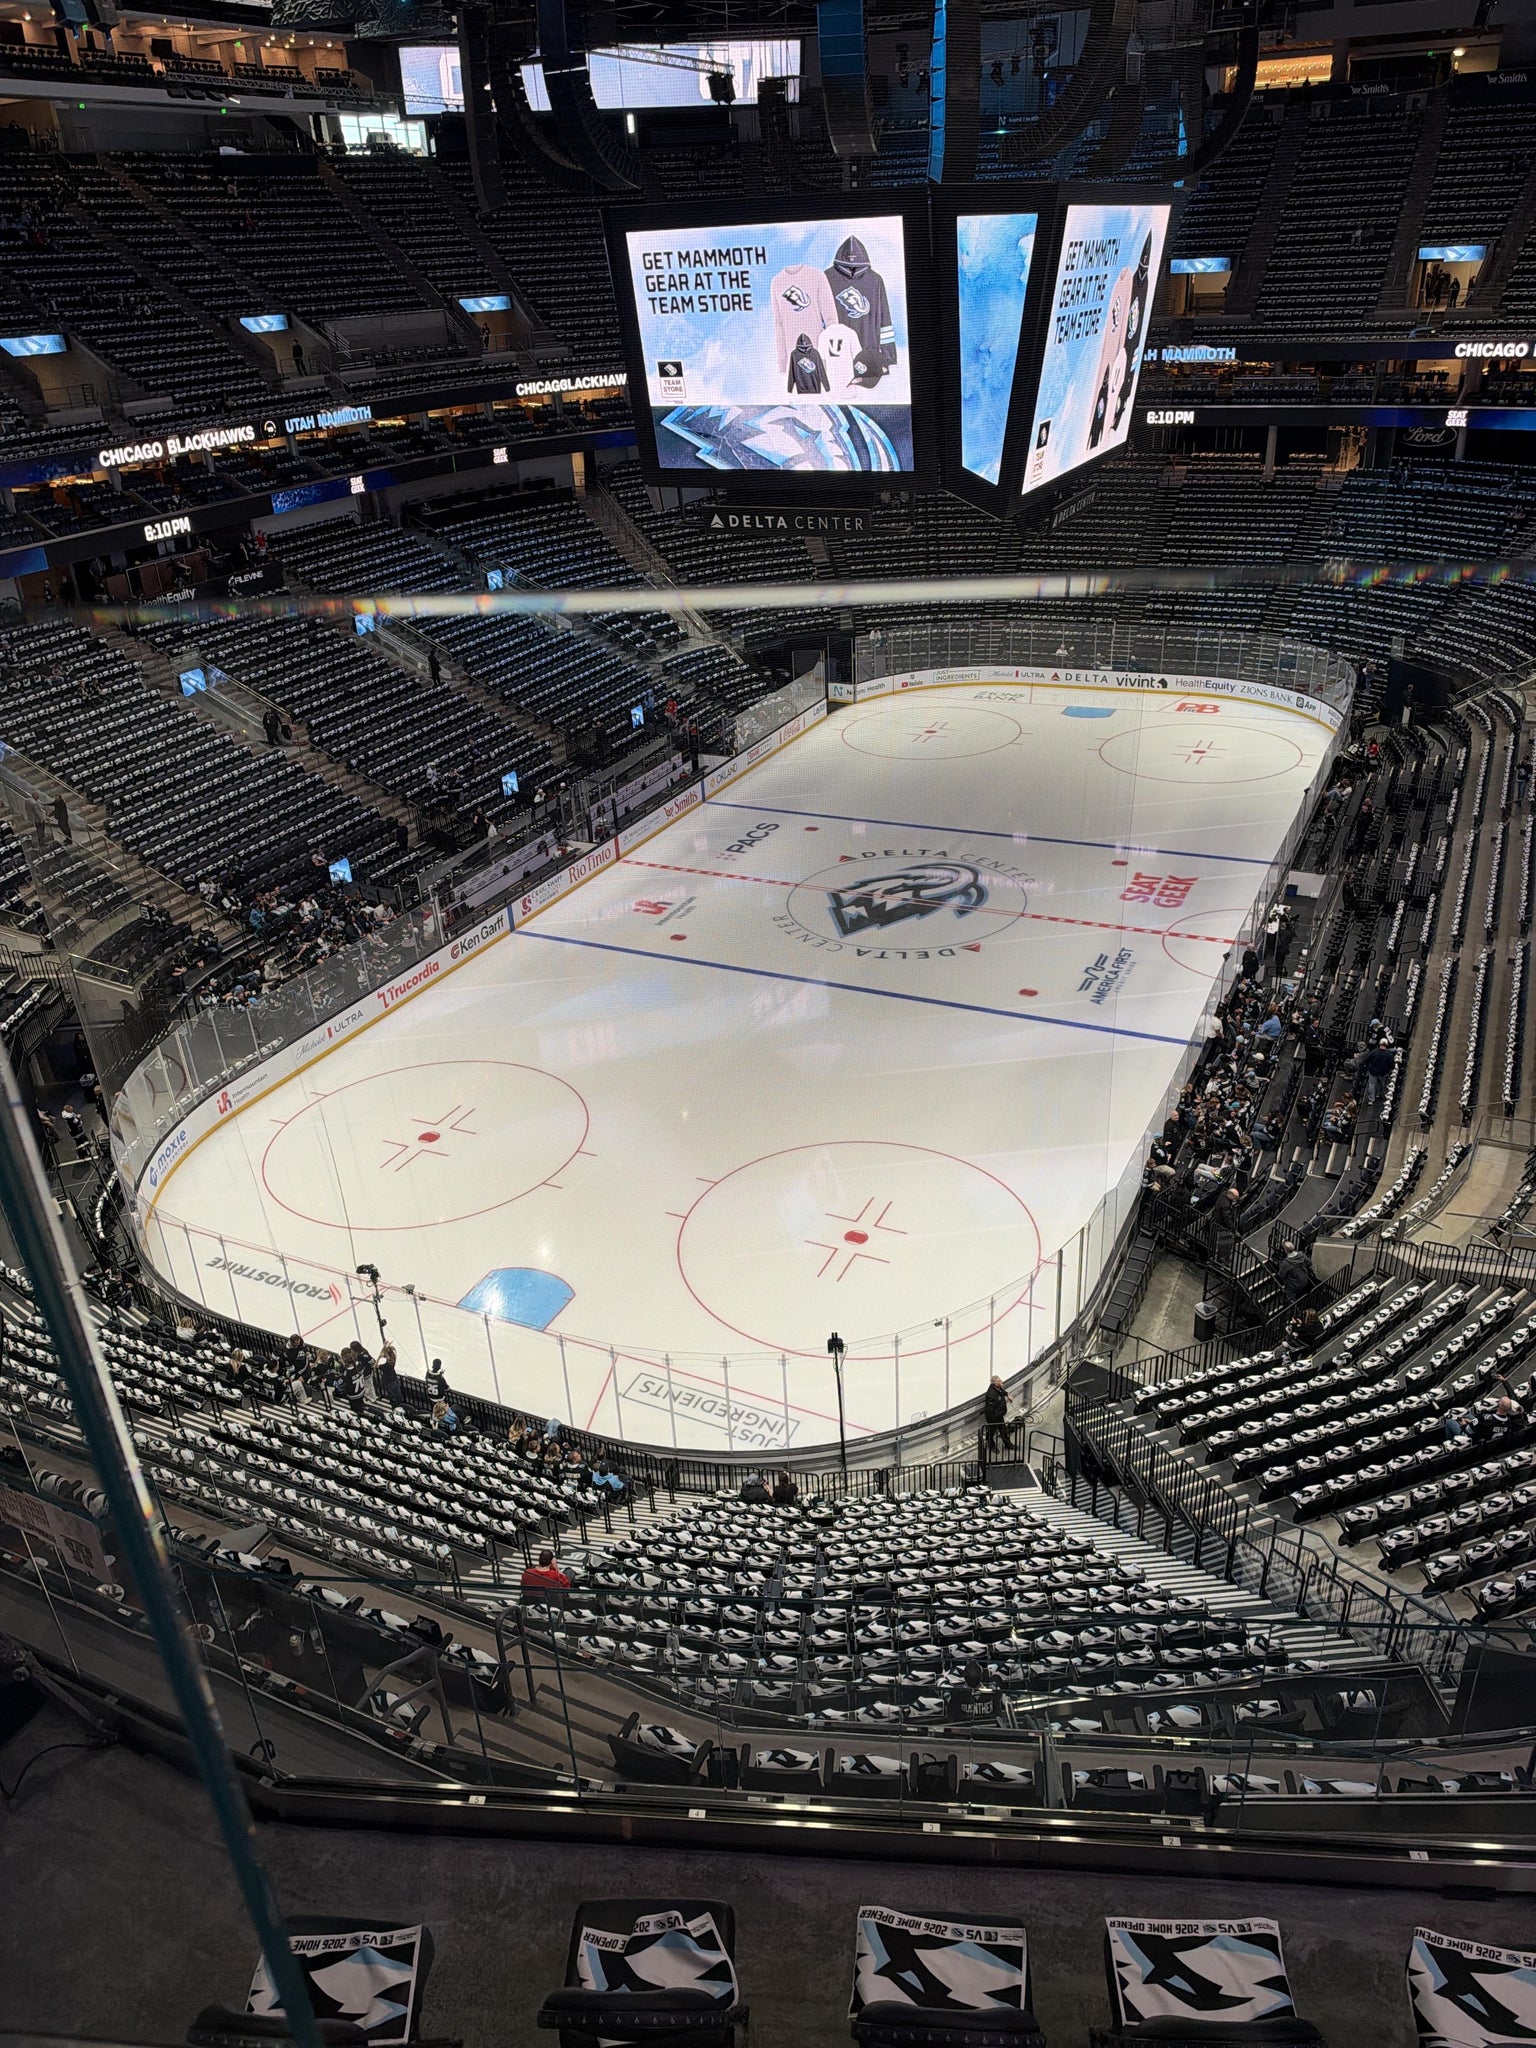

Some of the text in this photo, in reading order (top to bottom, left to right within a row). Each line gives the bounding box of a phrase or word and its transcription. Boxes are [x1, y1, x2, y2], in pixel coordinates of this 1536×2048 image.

[1362, 84, 1389, 95] Smith's
[643, 246, 767, 270] GET MAMMOTH
[1065, 238, 1121, 271] GET MAMMOTH
[645, 270, 751, 292] GEAR AT THE
[1059, 273, 1108, 309] GEAR AT THE
[648, 293, 753, 314] TEAM STORE
[1053, 308, 1102, 345] TEAM STORE
[1161, 347, 1236, 360] MAMMOTH
[1455, 343, 1529, 357] CHICAGO
[285, 406, 372, 434] UTAH MAMMOTH
[1147, 411, 1195, 424] 6:10 PM
[1445, 418, 1467, 427] GEEK
[1447, 410, 1468, 419] SEAT
[1402, 427, 1447, 443] Ford
[99, 425, 255, 468] CHICAGO BLACKHAWKS
[493, 447, 508, 456] SEAT
[144, 516, 191, 542] 6:10 PM
[728, 514, 864, 531] DELTA CENTER
[234, 570, 264, 585] FILEVINE
[935, 672, 978, 681] INGREDIENTS
[1020, 671, 1045, 679] ULTRA
[1065, 673, 1109, 684] DELTA
[1175, 678, 1237, 693] HealthEquity
[1240, 685, 1294, 704] ZIONS BANK
[716, 763, 738, 784] OKLAND
[674, 790, 699, 815] Smith's
[725, 822, 780, 854] PACS
[568, 847, 611, 884] Rio Tinto
[861, 848, 1036, 885] DELTA CENTER
[1120, 872, 1163, 903] SEAT
[1153, 875, 1199, 908] GEEK
[459, 914, 505, 954] Ken Garff
[772, 914, 956, 960] DELTA CENTER
[386, 960, 440, 1000] Trucordia
[1090, 947, 1135, 1006] AMERICA FIRST
[333, 1009, 364, 1033] ULTRA
[232, 1073, 269, 1099] Intermountain
[157, 1129, 187, 1167] moxie
[205, 1256, 332, 1300] CROWDSTRIKE
[427, 1383, 439, 1396] 26
[638, 1380, 787, 1435] INGREDIENTS
[725, 1426, 787, 1448] JUST
[667, 1915, 681, 1928] VS
[859, 1909, 983, 1941] VS 2026 HOME OPENER
[1109, 1920, 1237, 1934] VS 2026 HOME OPENER
[292, 1934, 378, 1952] VS 2026 HOME
[583, 1931, 618, 1950] OPENER
[1413, 1928, 1444, 1946] OPENE
[1446, 1940, 1474, 1954] HOME
[1475, 1946, 1502, 1960] 2026
